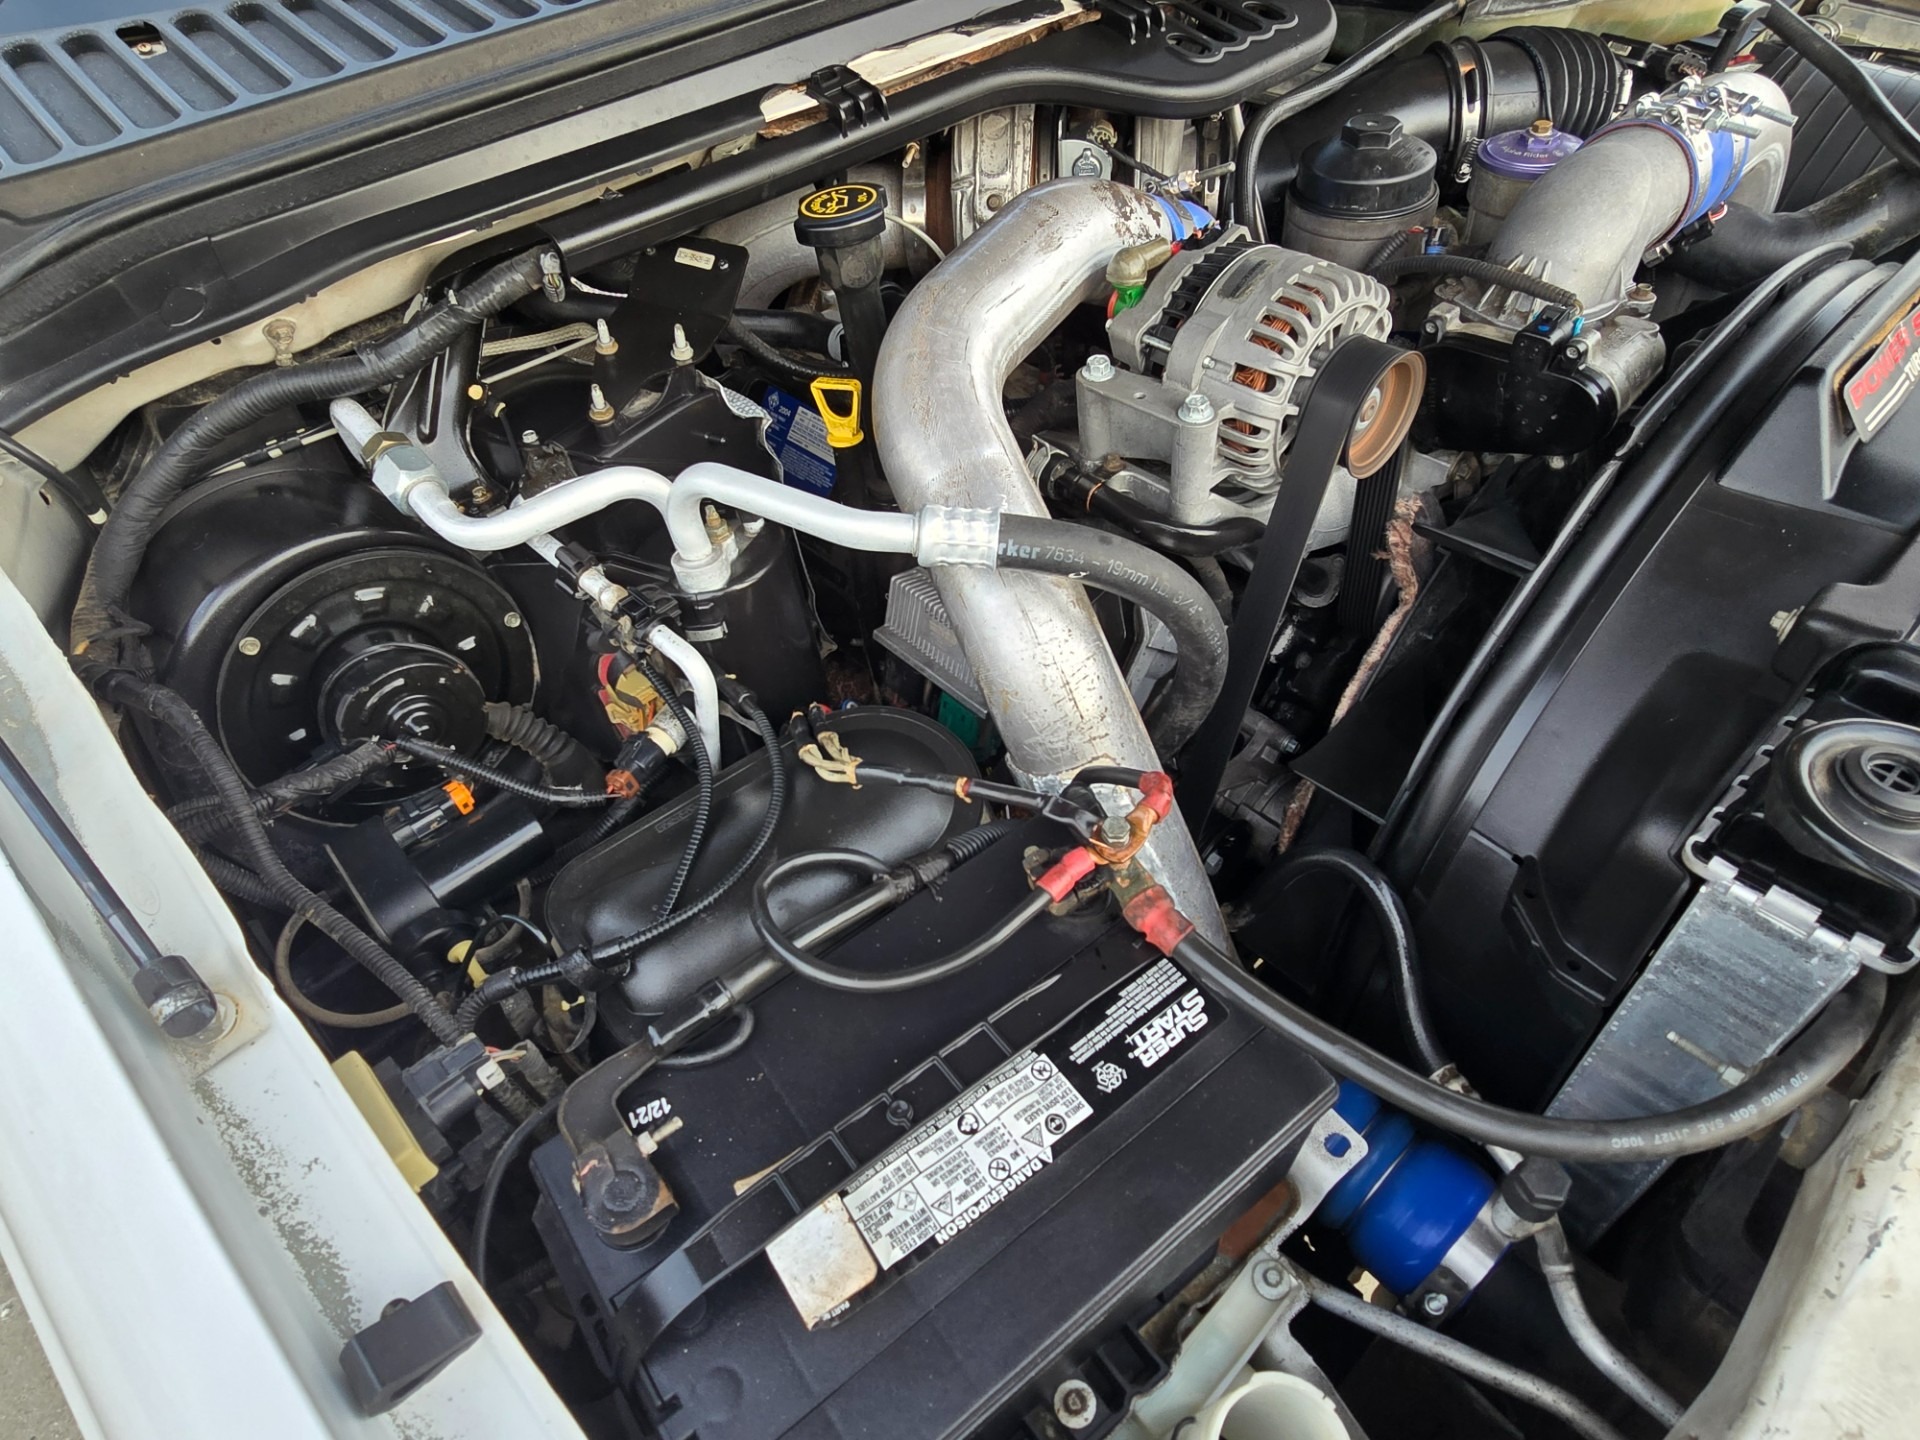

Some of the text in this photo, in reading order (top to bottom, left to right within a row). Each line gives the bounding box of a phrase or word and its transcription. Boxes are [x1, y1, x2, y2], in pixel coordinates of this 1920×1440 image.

[1849, 326, 1911, 410] POWER
[999, 539, 1041, 559] rker
[1044, 546, 1085, 565] 7634
[1107, 559, 1149, 586] 19mm
[1133, 987, 1205, 1055] START
[1140, 1012, 1209, 1067] SUPER
[1023, 1086, 1072, 1124] EXPLOSIVE GASES
[1761, 1085, 1787, 1107] AWG
[628, 1097, 672, 1129] 12/21
[1012, 1097, 1040, 1120] BLINDNESS
[1063, 1100, 1085, 1119] SHIELD
[1654, 1128, 1690, 1146] J1127
[1697, 1118, 1724, 1135] SAE
[943, 1135, 958, 1148] READ
[1610, 1136, 1645, 1149] 105C
[942, 1149, 964, 1168] SEVERE
[1009, 1149, 1020, 1160] NO
[889, 1165, 902, 1177] NOT
[894, 1172, 907, 1183] NOT
[929, 1156, 968, 1187] BLINDNESS OR
[943, 1163, 973, 1188] CAN CAUSE
[962, 1171, 979, 1186] ACID
[878, 1180, 895, 1195] OPEN
[953, 1178, 985, 1205] SULFURIC
[875, 1198, 894, 1215] HELP
[933, 1157, 1044, 1244] DANGER/POISON
[863, 1210, 893, 1236] MEDICAL
[884, 1206, 927, 1241] WITH WATER.
[888, 1214, 933, 1249] IMMEDIATELY
[867, 1230, 882, 1243] GET
[898, 1222, 938, 1254] FLUSH EYES
